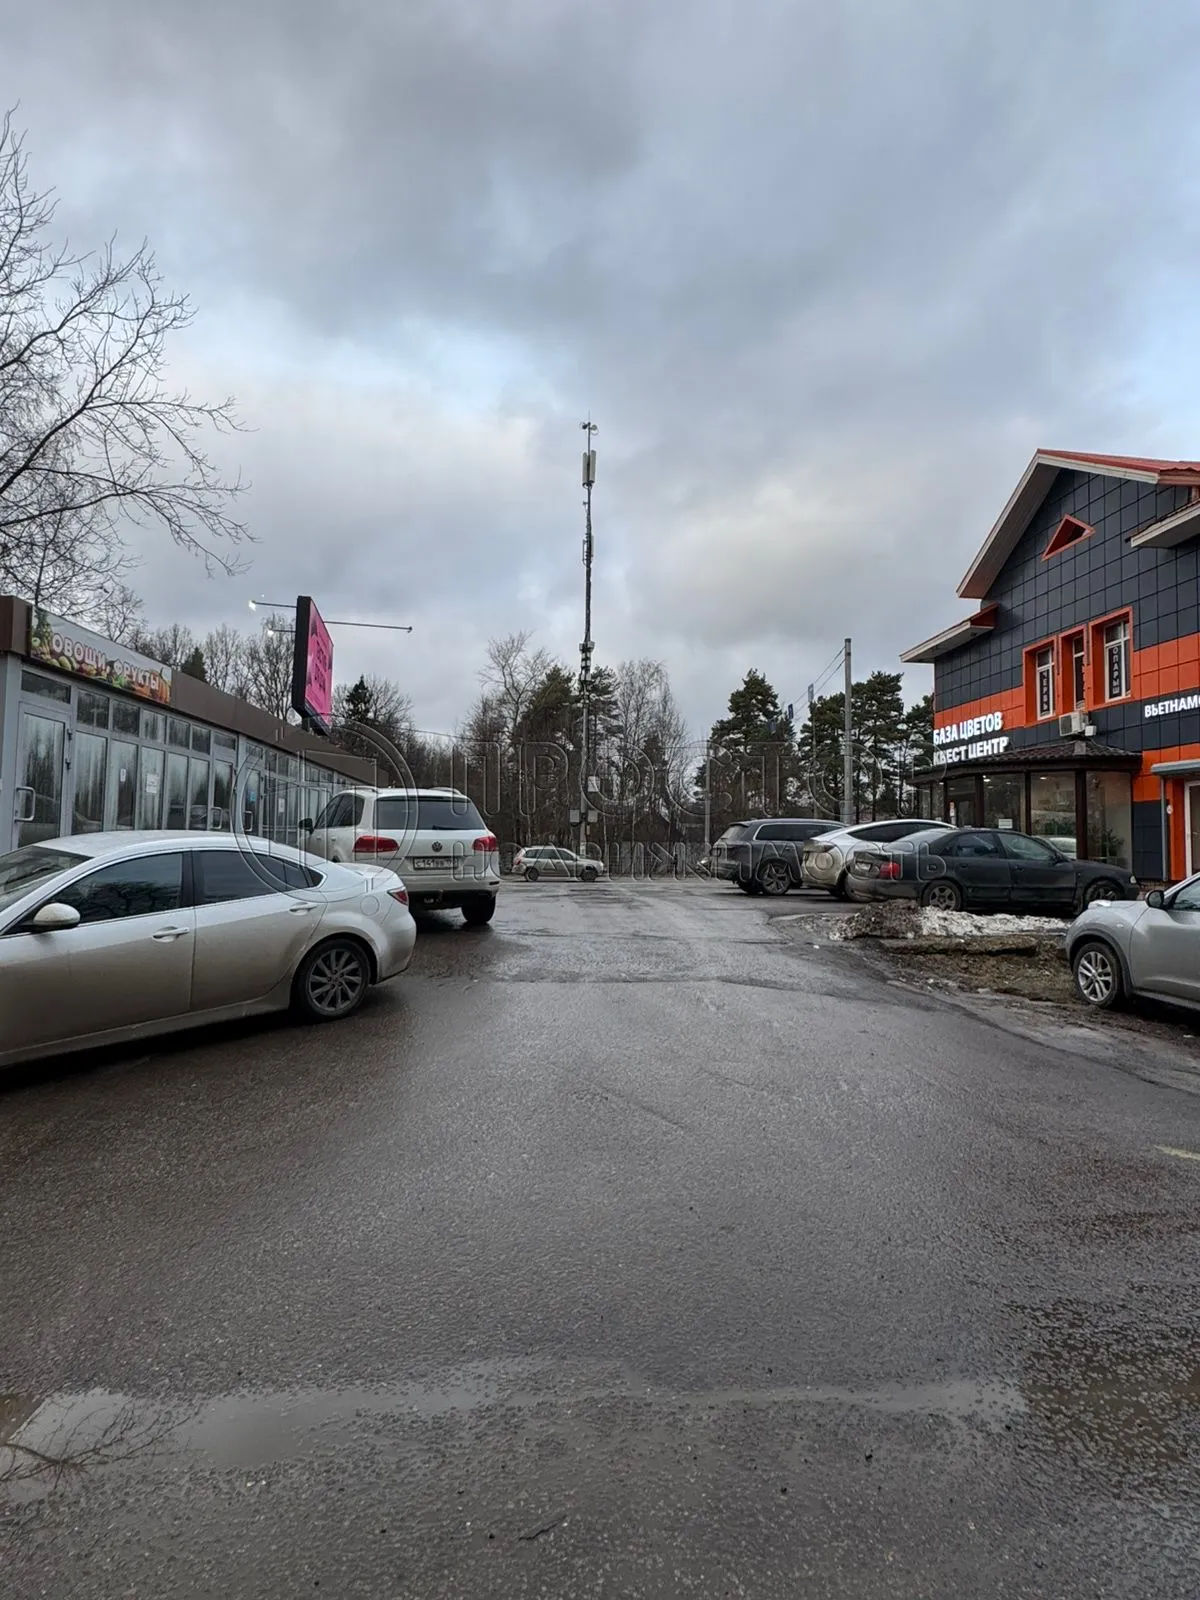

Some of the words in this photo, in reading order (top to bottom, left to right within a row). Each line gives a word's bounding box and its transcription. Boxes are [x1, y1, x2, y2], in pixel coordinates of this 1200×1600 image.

[113, 659, 160, 691] ФРУКТЫ
[1112, 646, 1120, 695] ОПАРЫШ
[1144, 694, 1200, 718] ВЬЕТНАМ
[933, 724, 958, 745] БАЗА
[959, 711, 1003, 740] ЦВЕТОВ
[933, 745, 967, 766] КВЕСТ
[967, 736, 1009, 759] ЦЕНТР
